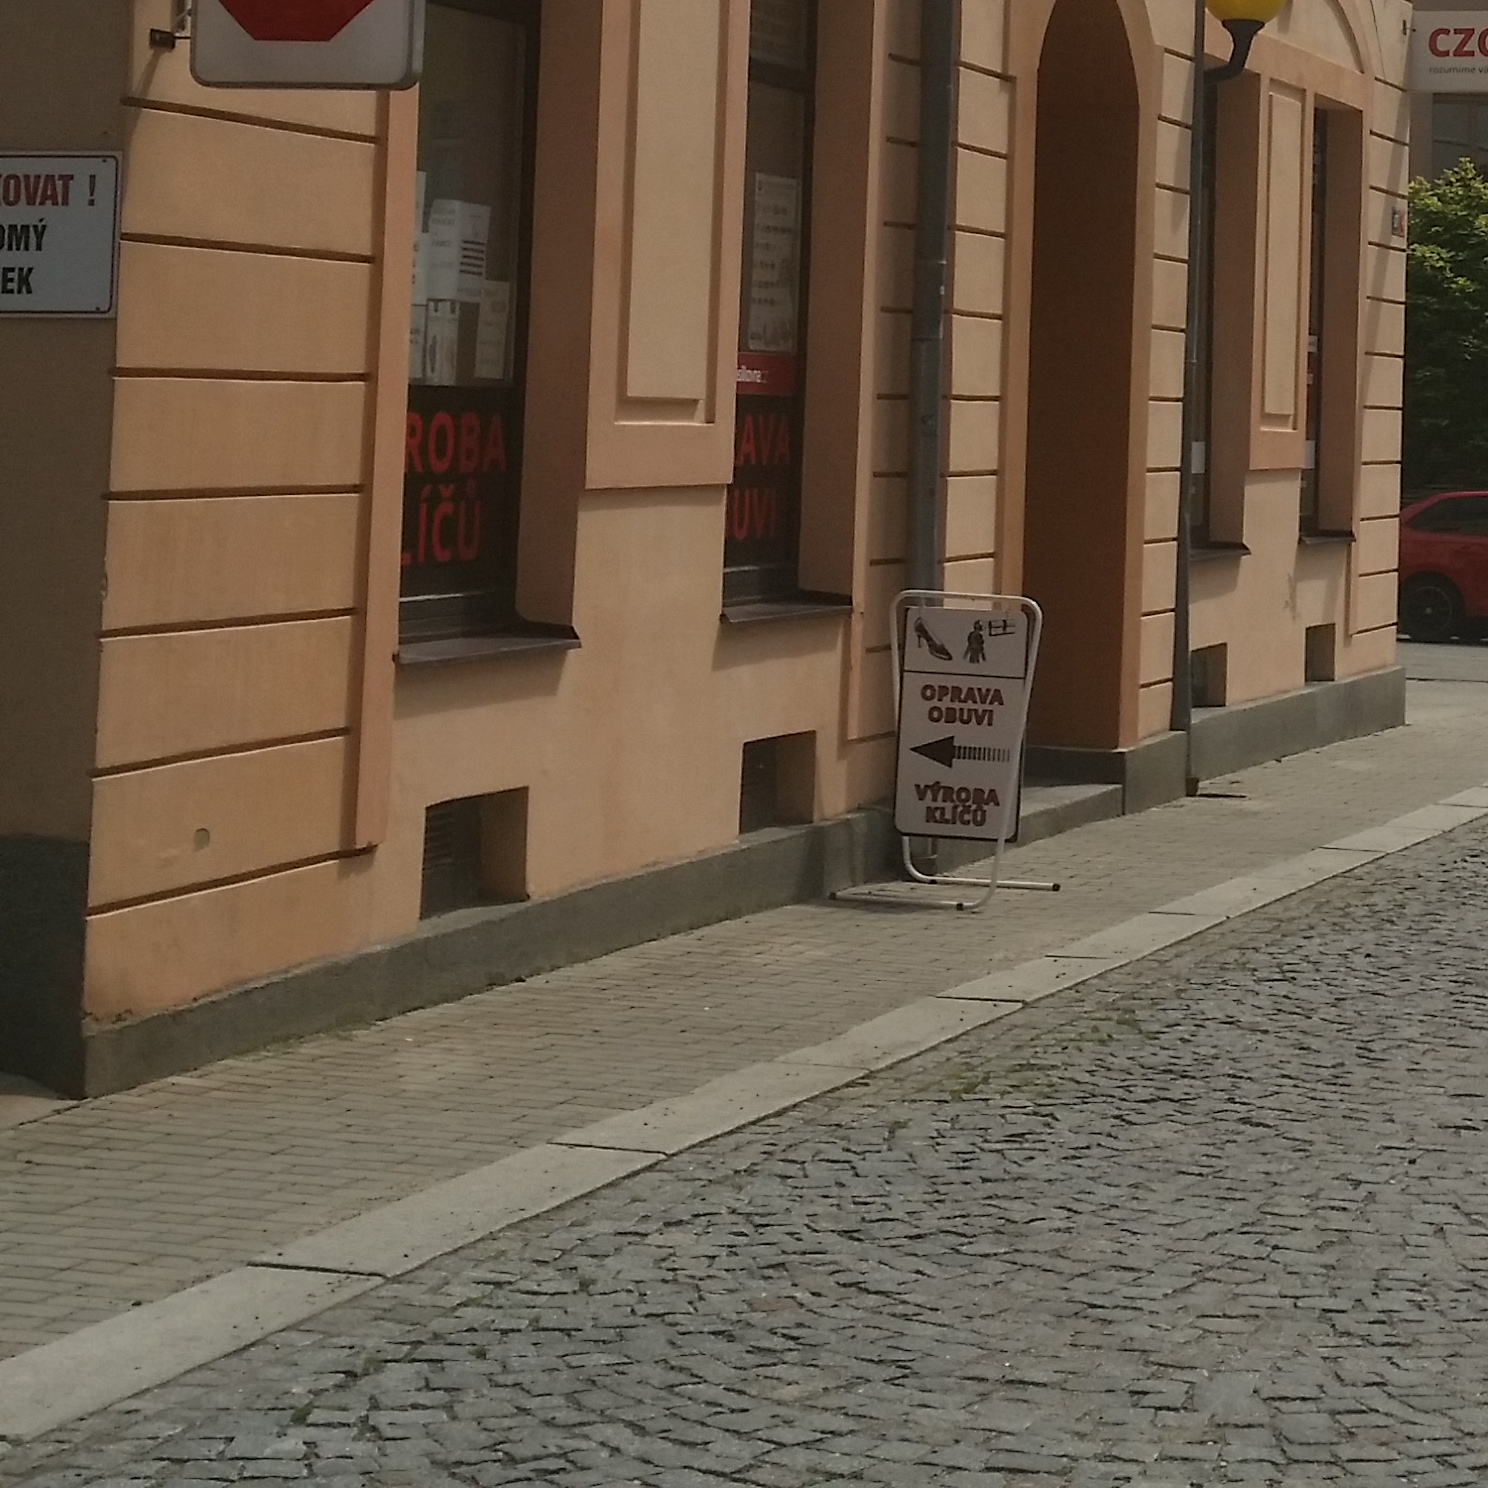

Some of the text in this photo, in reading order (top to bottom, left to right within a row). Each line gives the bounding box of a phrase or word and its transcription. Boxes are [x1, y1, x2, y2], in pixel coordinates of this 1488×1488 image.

[0, 173, 74, 207] OVAT
[735, 413, 791, 465] AVA
[726, 487, 777, 539] UVI
[920, 684, 1004, 706] OPRAVA
[928, 706, 994, 726] OBUVI
[914, 781, 1000, 807] VÝROBA
[925, 804, 987, 827] KLÍČŮ
